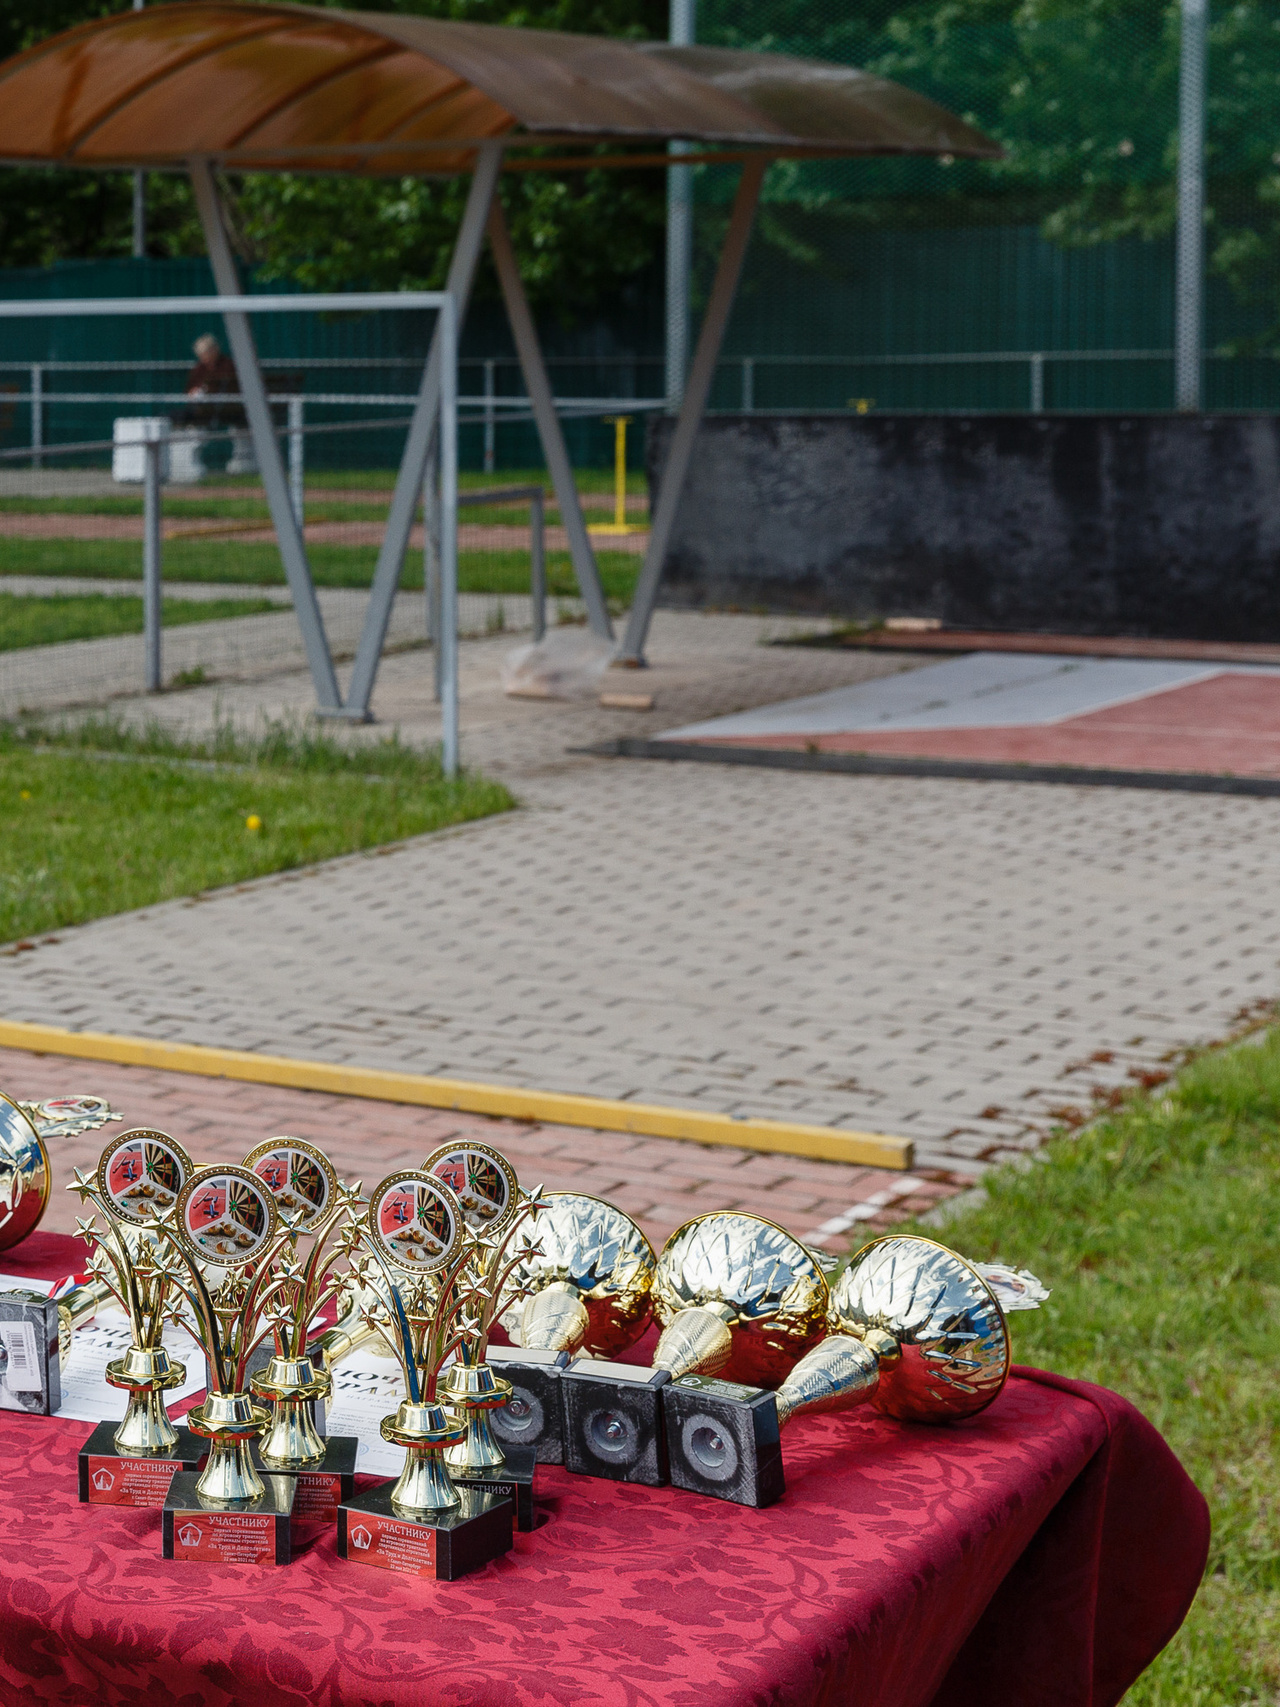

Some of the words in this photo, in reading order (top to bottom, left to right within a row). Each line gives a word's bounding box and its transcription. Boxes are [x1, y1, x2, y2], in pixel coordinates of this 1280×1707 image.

[120, 1461, 178, 1473] УЧАСТНИКУ
[297, 1476, 336, 1486] СТНИКУ
[209, 1516, 270, 1528] УЧАСТНИКУ
[377, 1521, 431, 1540] УЧАСТНИКУ
